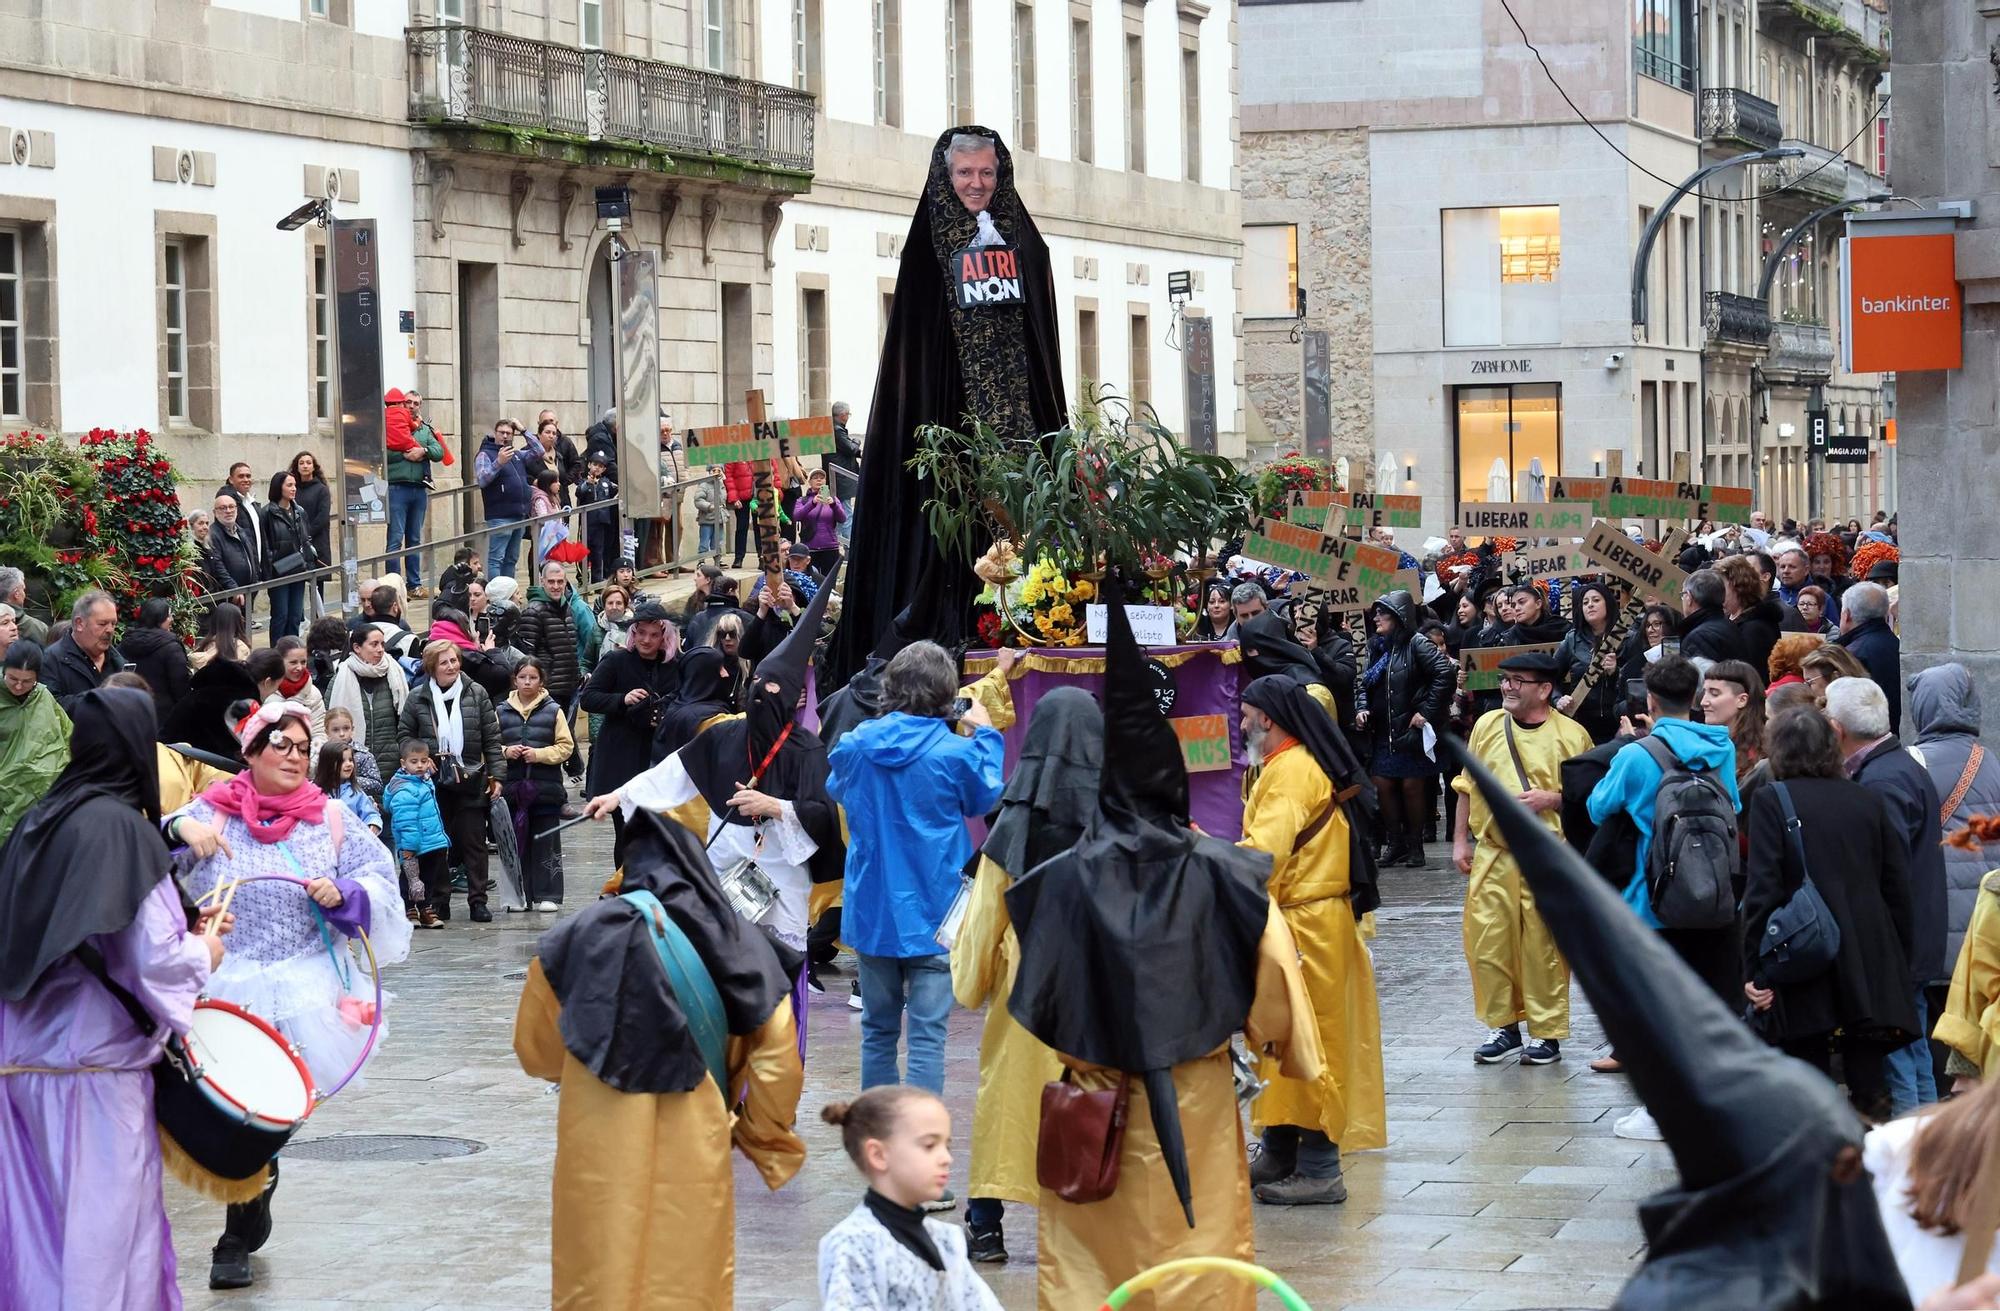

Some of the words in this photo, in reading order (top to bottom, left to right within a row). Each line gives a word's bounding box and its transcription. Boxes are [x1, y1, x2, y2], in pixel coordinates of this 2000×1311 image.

[962, 250, 1017, 282] ALTRI
[355, 230, 372, 327] MUSEO
[687, 428, 699, 448] A
[753, 421, 778, 440] FAI
[780, 438, 790, 458] E
[1850, 447, 1867, 456] JOYA
[1568, 482, 1605, 499] UNIO
[1611, 476, 1622, 494] A
[1678, 481, 1700, 501] FAI
[1292, 490, 1304, 507] A
[1353, 493, 1374, 509] FAI
[1373, 510, 1383, 527] E
[1465, 511, 1528, 528] LIBERAR
[1534, 511, 1545, 529] A
[1697, 502, 1709, 520] E
[1319, 533, 1347, 559] FAI
[1337, 560, 1352, 582] E
[1592, 534, 1664, 588] LIBERAR
[1129, 609, 1163, 620] señora
